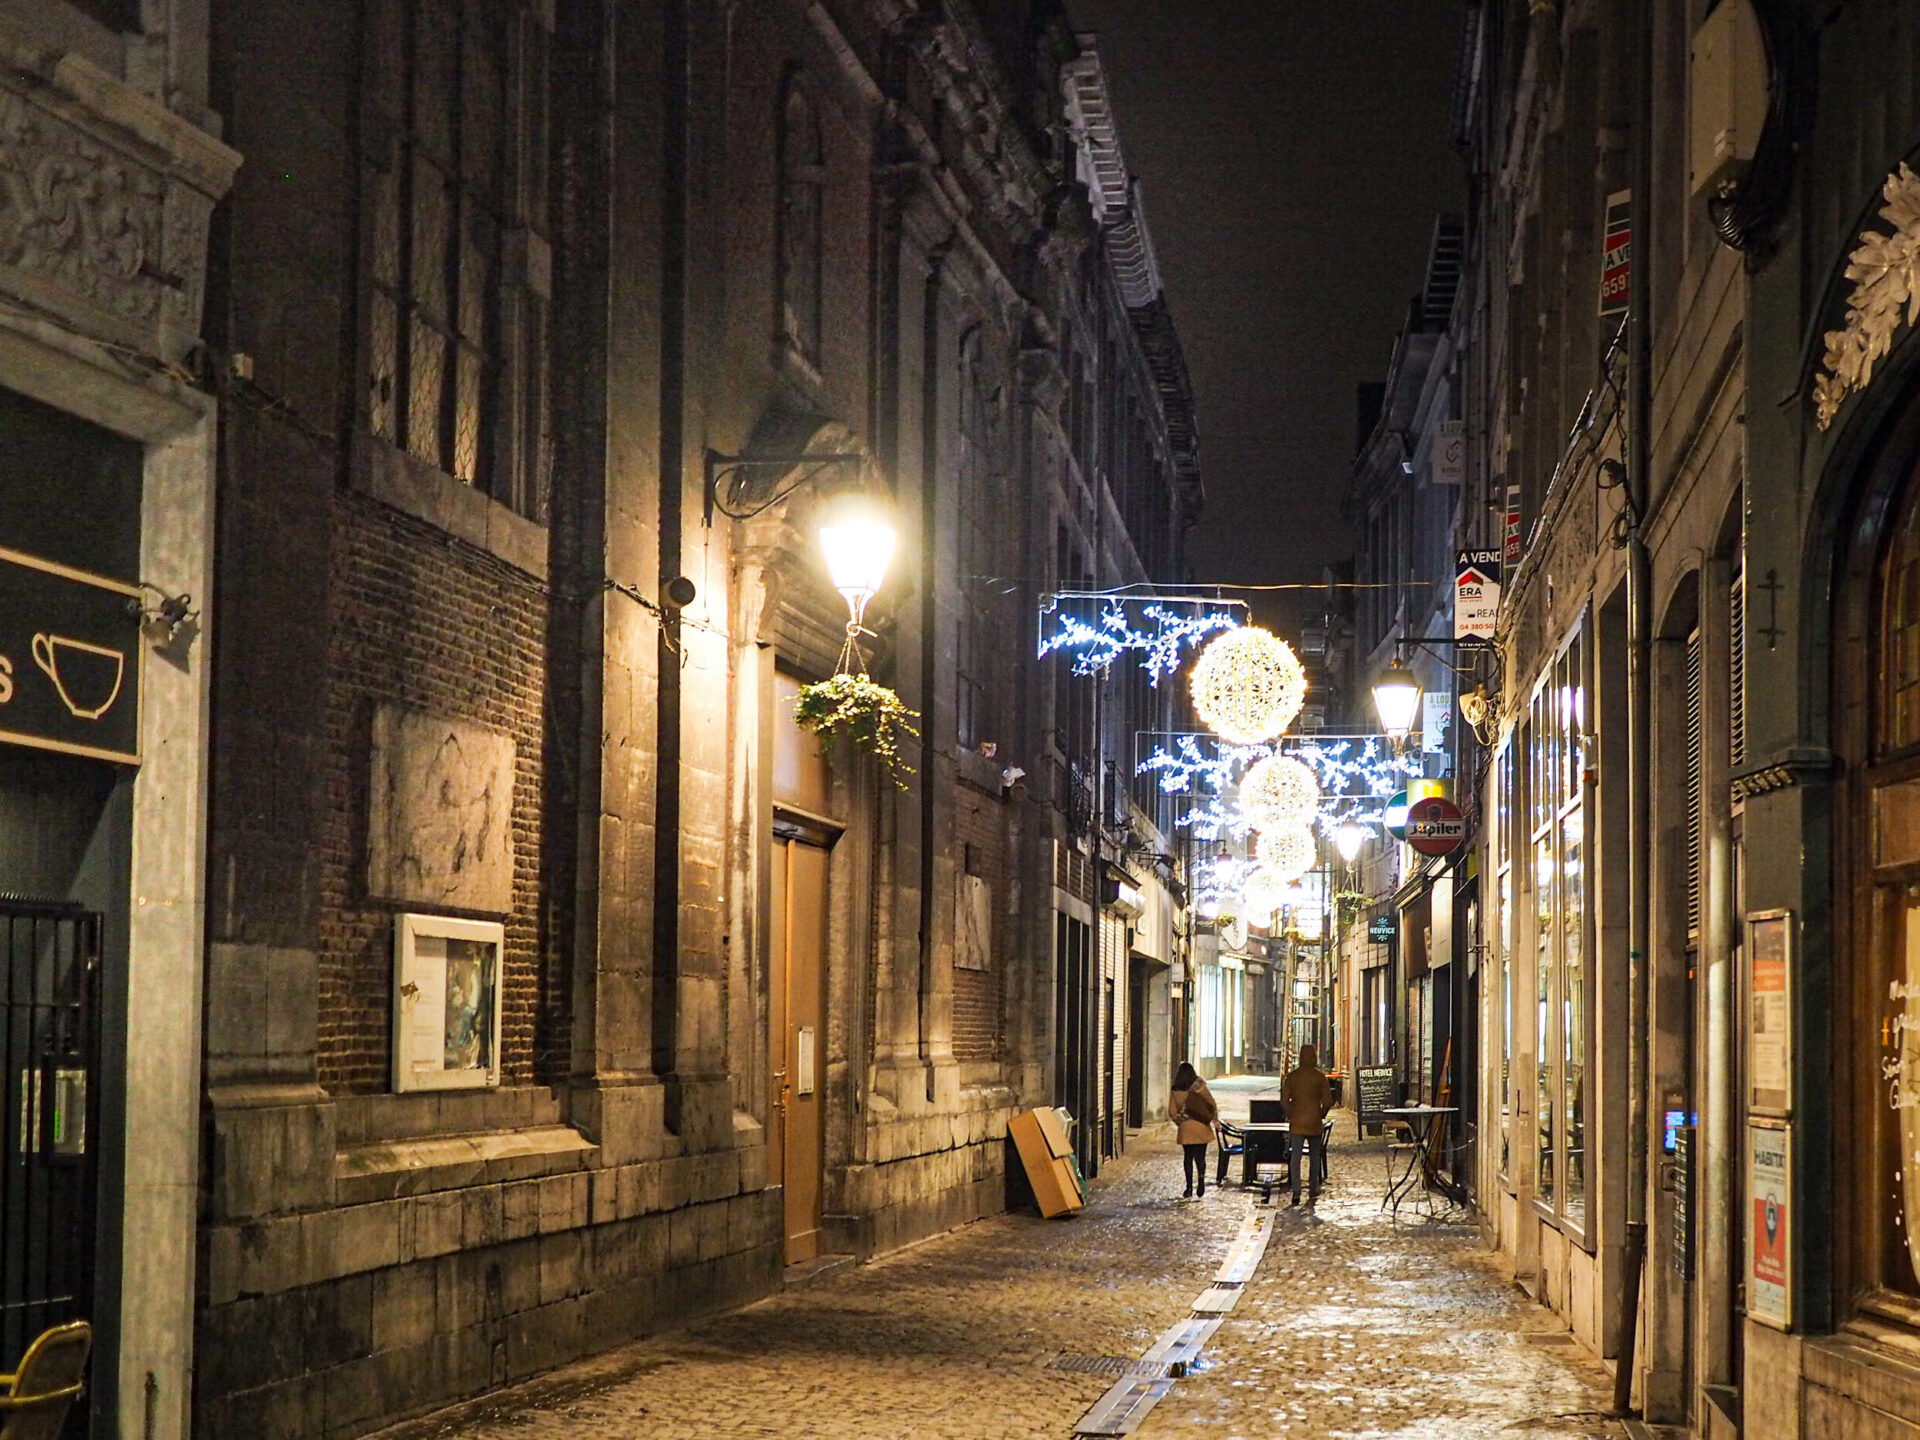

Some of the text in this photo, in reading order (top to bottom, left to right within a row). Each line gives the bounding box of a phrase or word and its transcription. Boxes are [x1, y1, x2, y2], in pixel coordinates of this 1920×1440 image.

[1459, 552, 1468, 564] A
[1459, 587, 1482, 597] ERA
[1410, 822, 1461, 838] Jupiler
[1369, 927, 1396, 935] NEUVICE
